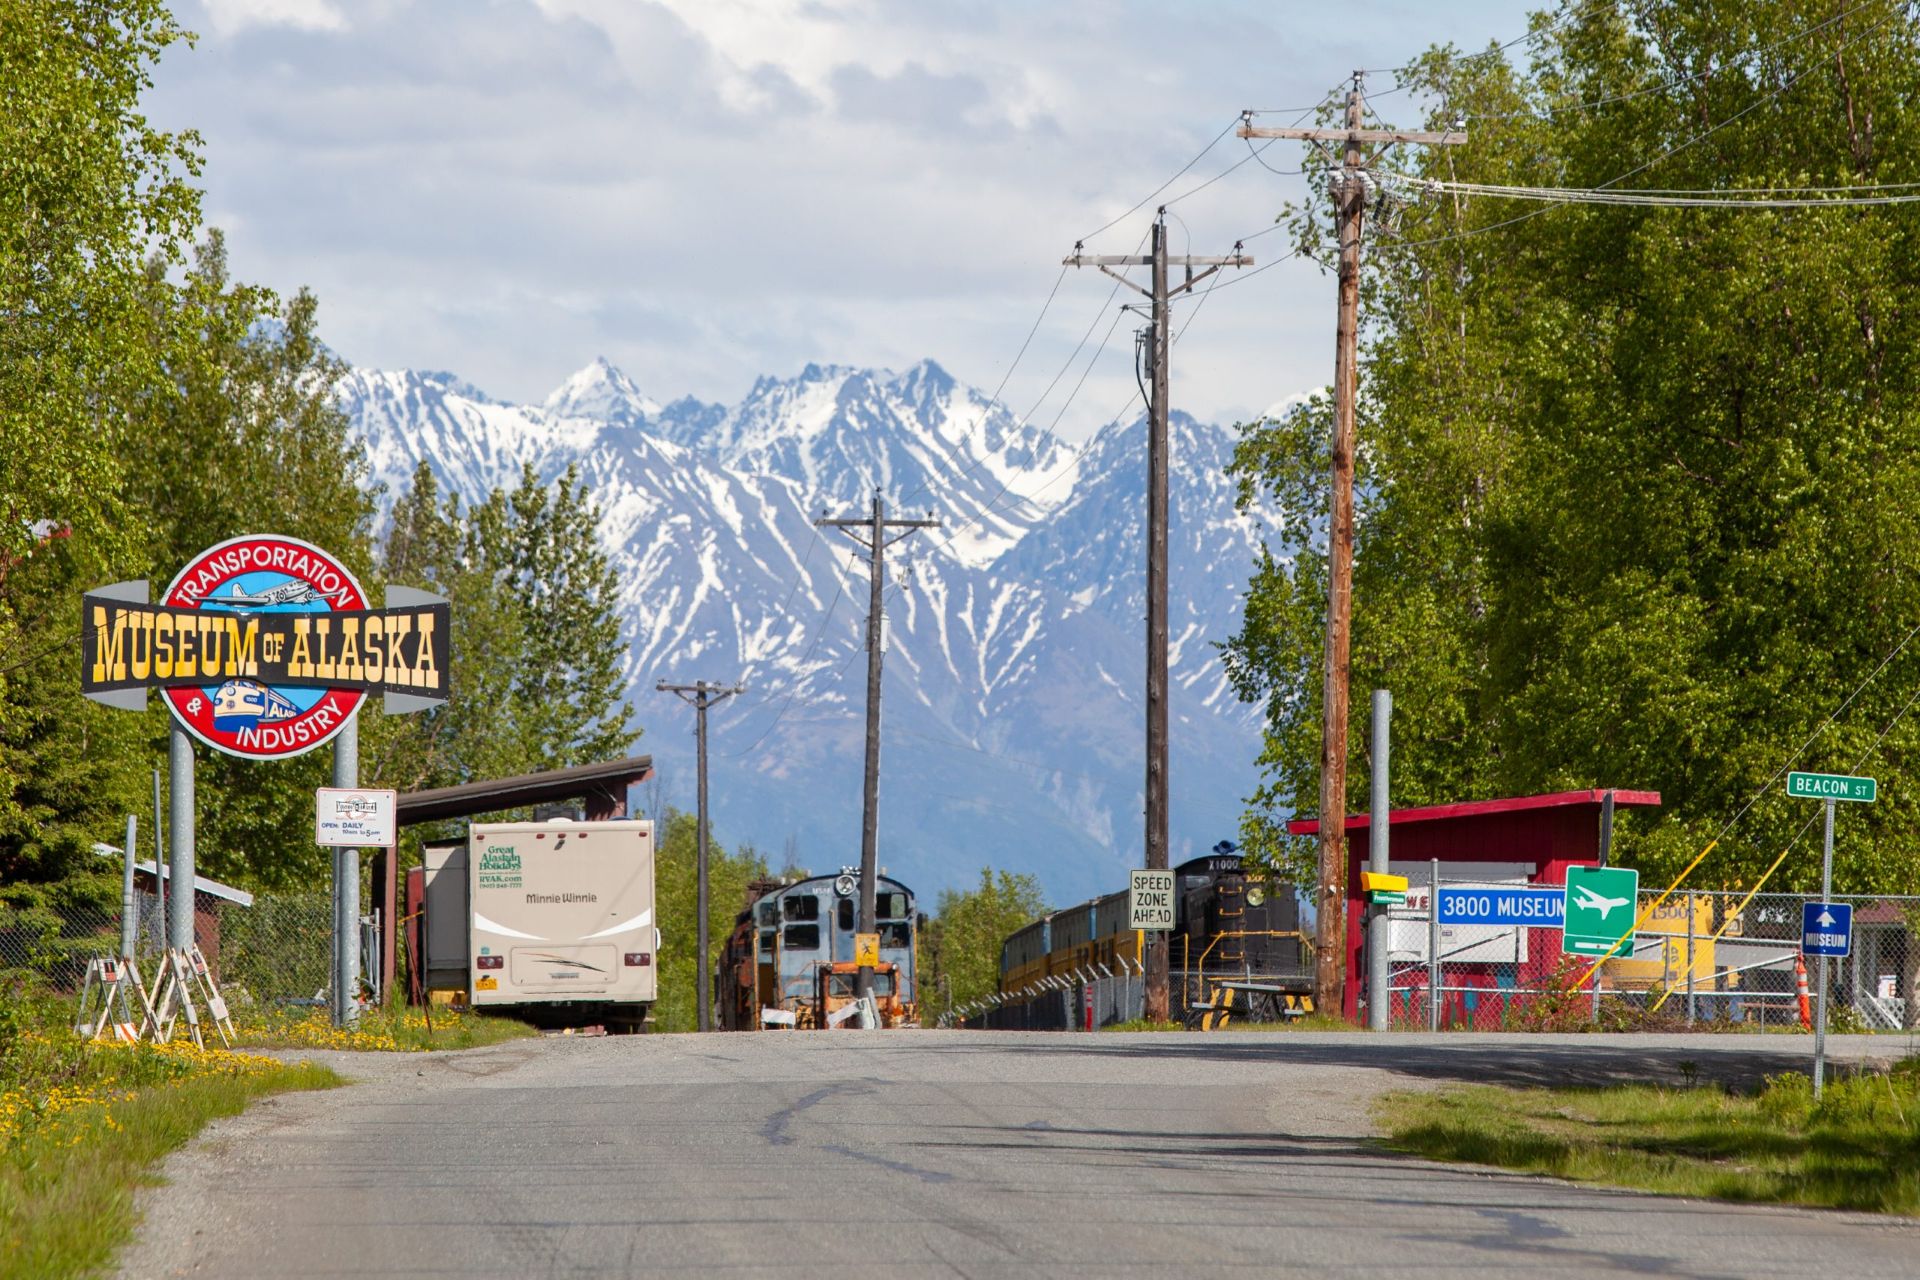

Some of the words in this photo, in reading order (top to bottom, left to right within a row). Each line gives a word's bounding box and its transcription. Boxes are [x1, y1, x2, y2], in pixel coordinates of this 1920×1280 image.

[176, 545, 354, 608] TRANSPORTATION
[93, 606, 259, 683] MUSEUM
[262, 632, 285, 663] OF
[287, 612, 439, 689] ALASKA
[186, 697, 202, 717] &
[236, 696, 342, 749] INDUSTRY
[1796, 777, 1848, 795] BEACON
[1855, 785, 1867, 796] ST
[488, 845, 514, 854] Great
[481, 853, 521, 865] Alaskan
[1209, 859, 1239, 870] X1000
[479, 862, 522, 871] Holidays
[1134, 876, 1172, 890] SPEED
[526, 893, 561, 904] Minnie
[562, 892, 598, 904] Winnie
[1137, 893, 1168, 906] ZONE
[1443, 896, 1490, 916] 3800
[1133, 909, 1171, 923] AHEAD
[1805, 932, 1846, 948] MUSEUM
